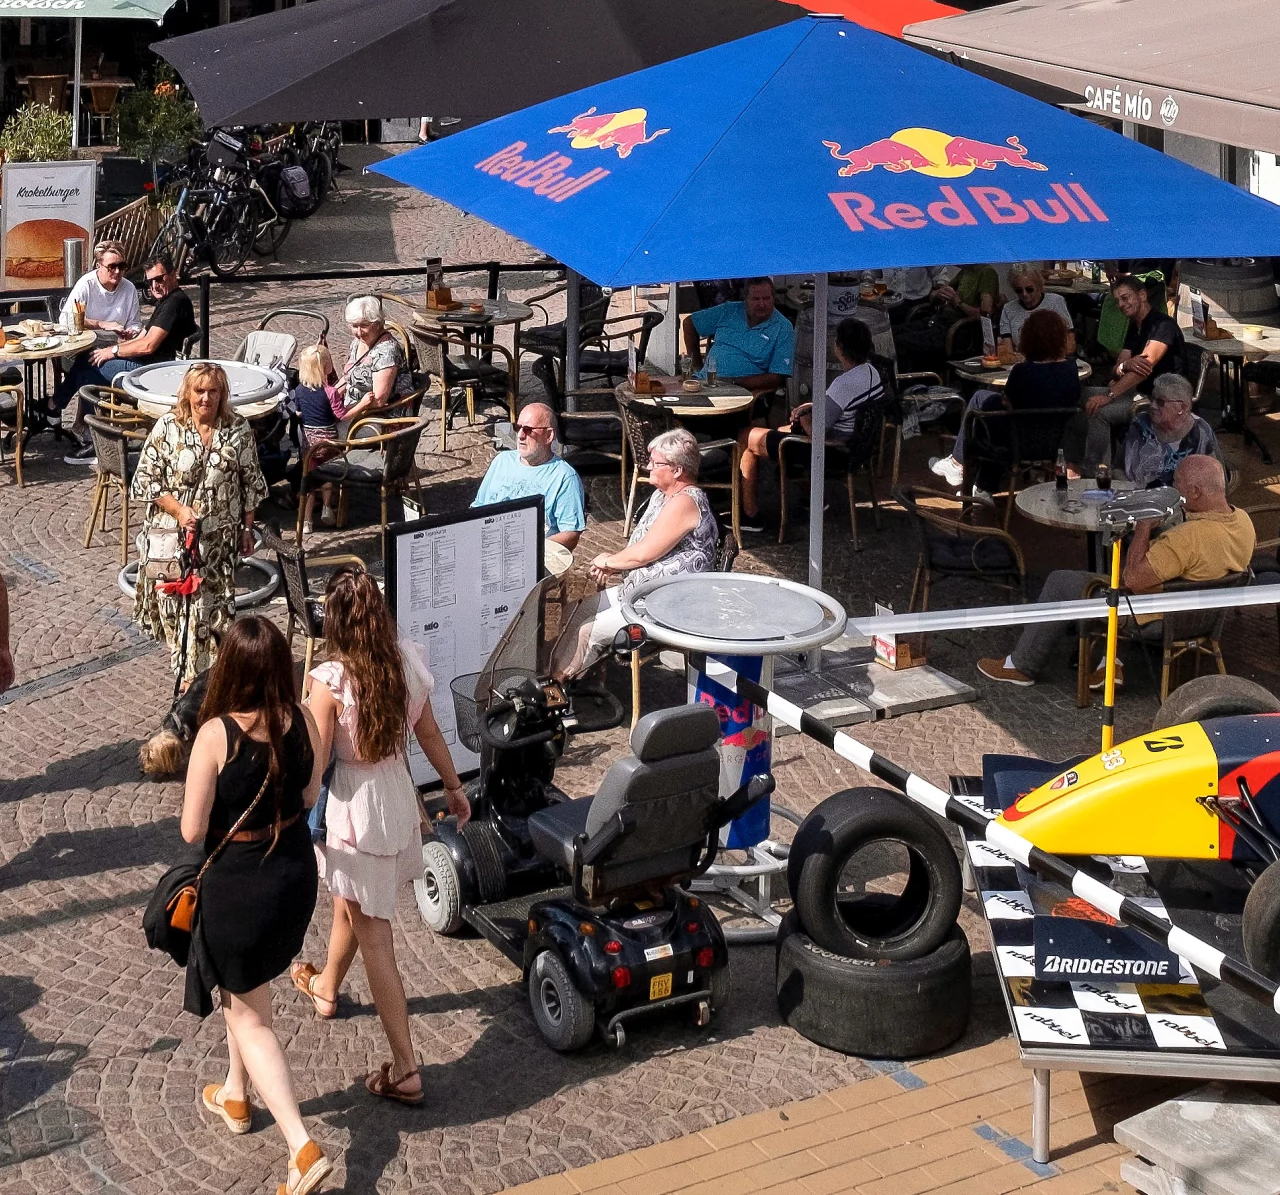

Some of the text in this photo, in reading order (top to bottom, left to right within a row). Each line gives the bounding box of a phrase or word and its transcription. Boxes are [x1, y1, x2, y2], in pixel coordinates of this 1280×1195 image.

[1125, 88, 1153, 121] MÍO
[827, 182, 1110, 233] Red Bull
[1043, 955, 1169, 976] BRIDGESTONE
[1080, 982, 1138, 1011] rabbel
[1024, 1011, 1081, 1040] rabbel
[1157, 1018, 1218, 1047] rabbel
